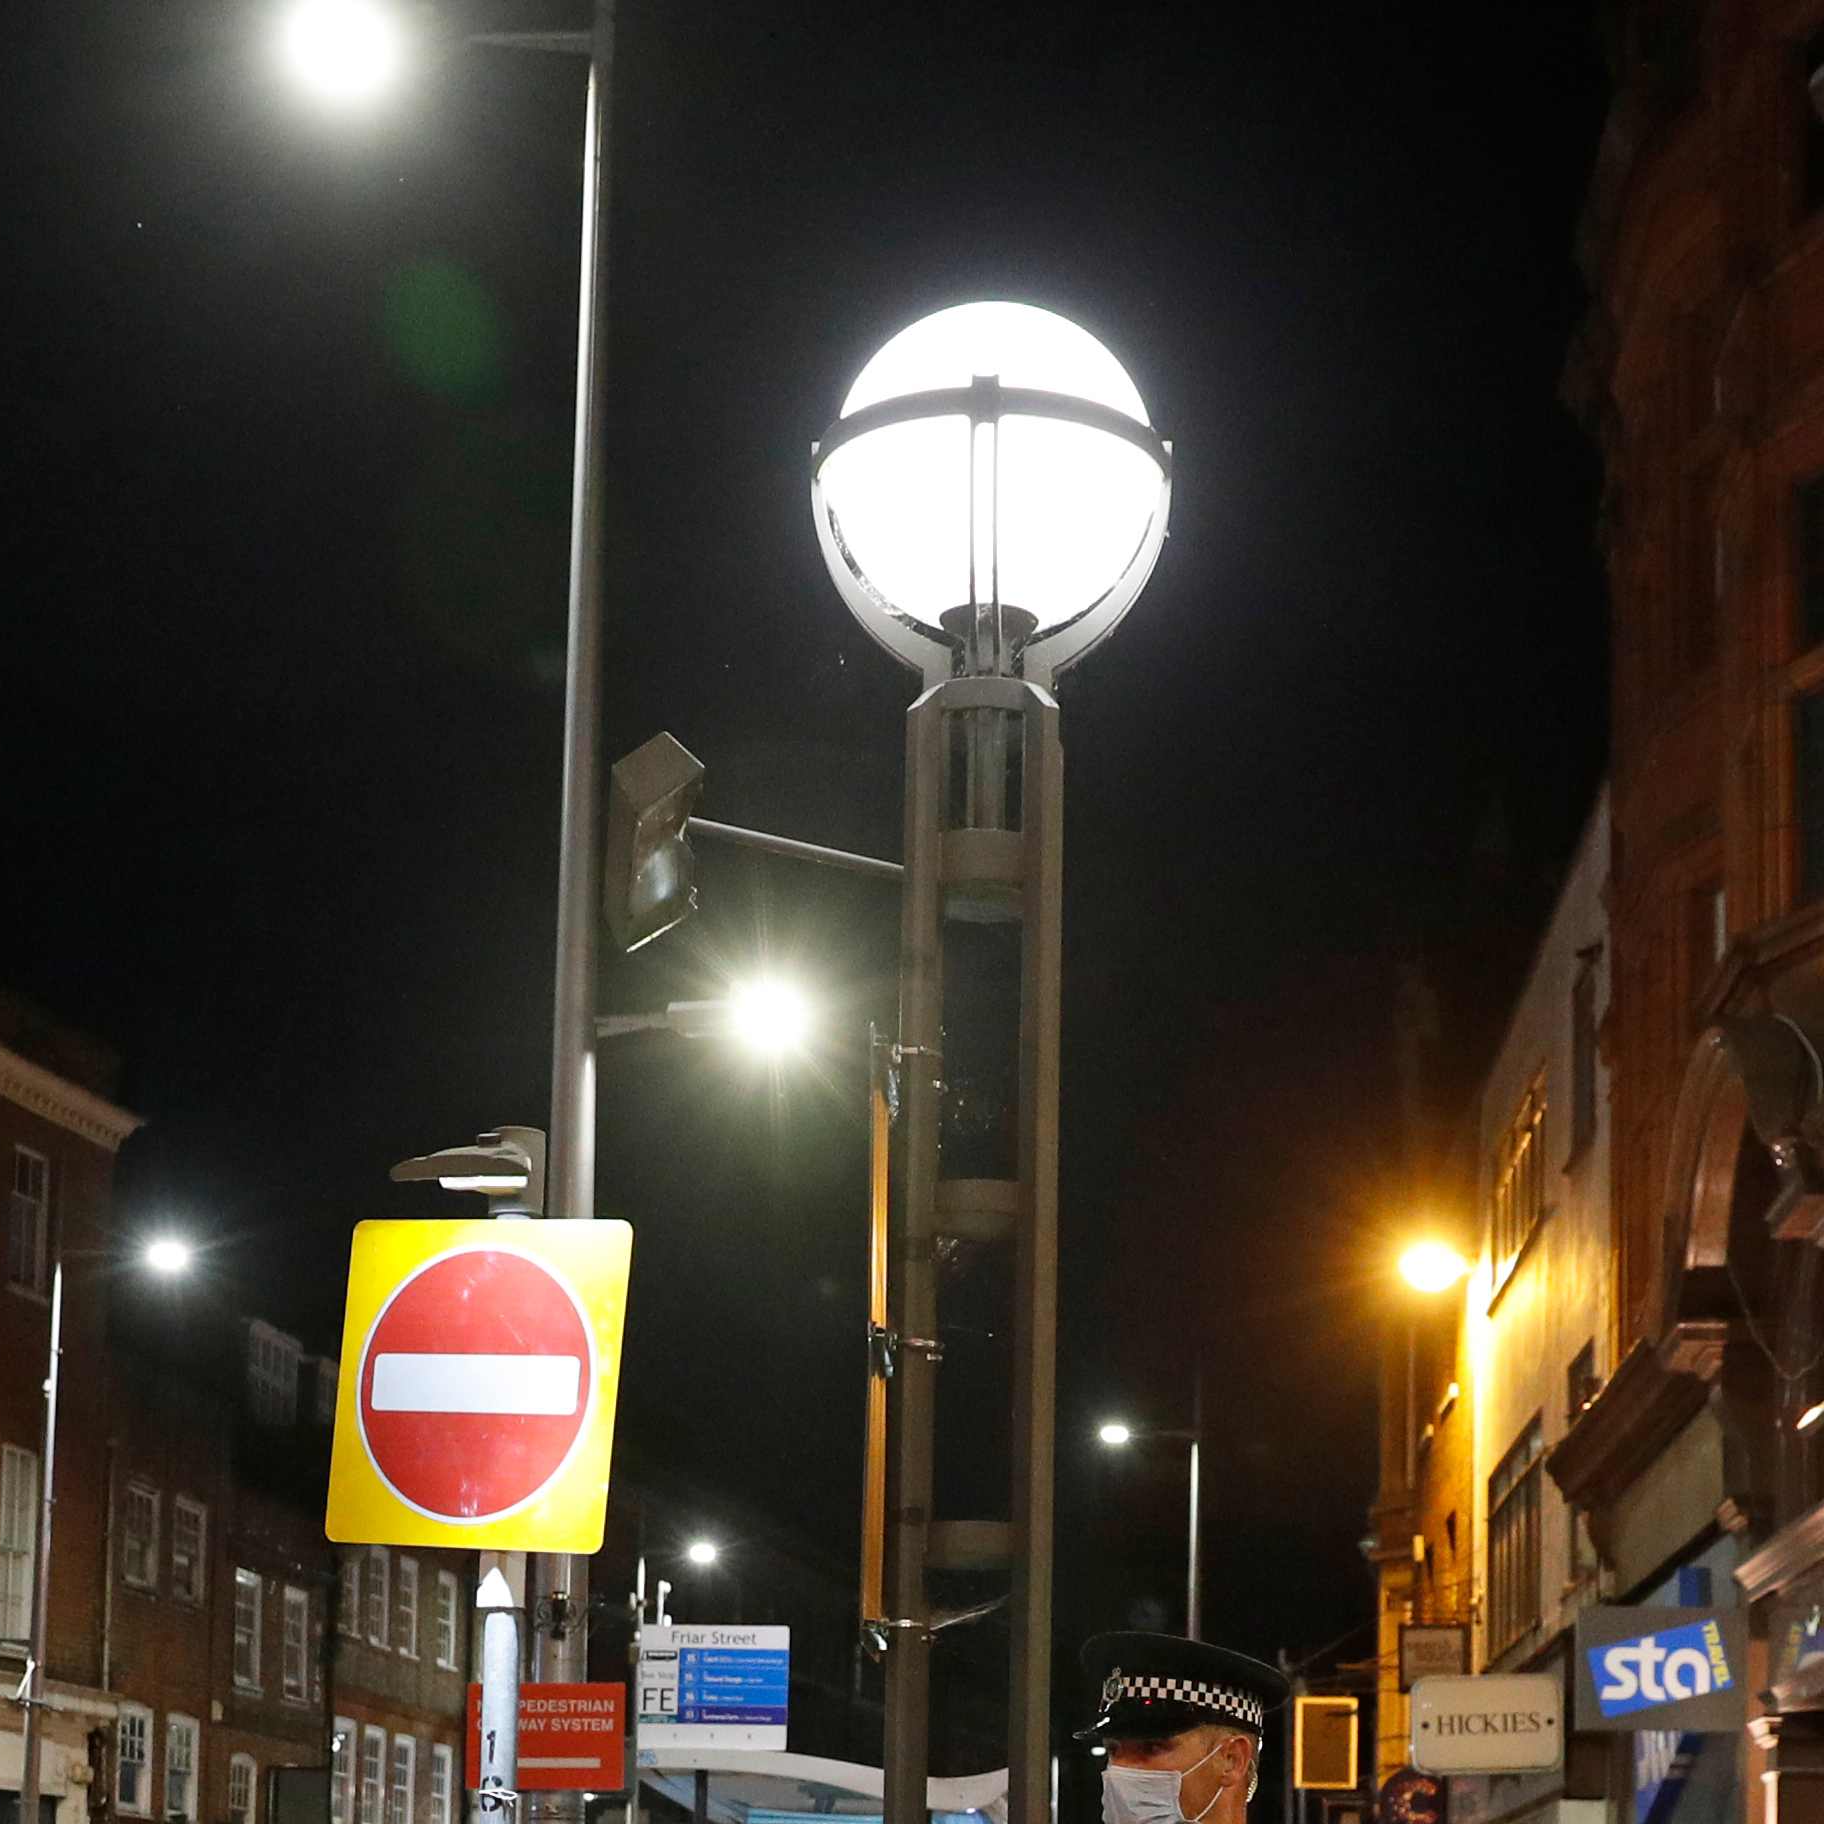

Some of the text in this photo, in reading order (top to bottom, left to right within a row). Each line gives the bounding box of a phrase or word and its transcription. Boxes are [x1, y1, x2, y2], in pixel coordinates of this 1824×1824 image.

[672, 1632, 758, 1648] Friar Street
[1600, 1636, 1713, 1702] sta
[642, 1687, 675, 1712] FE
[551, 1717, 615, 1732] SYSTEM
[1437, 1711, 1541, 1736] HICKIES
